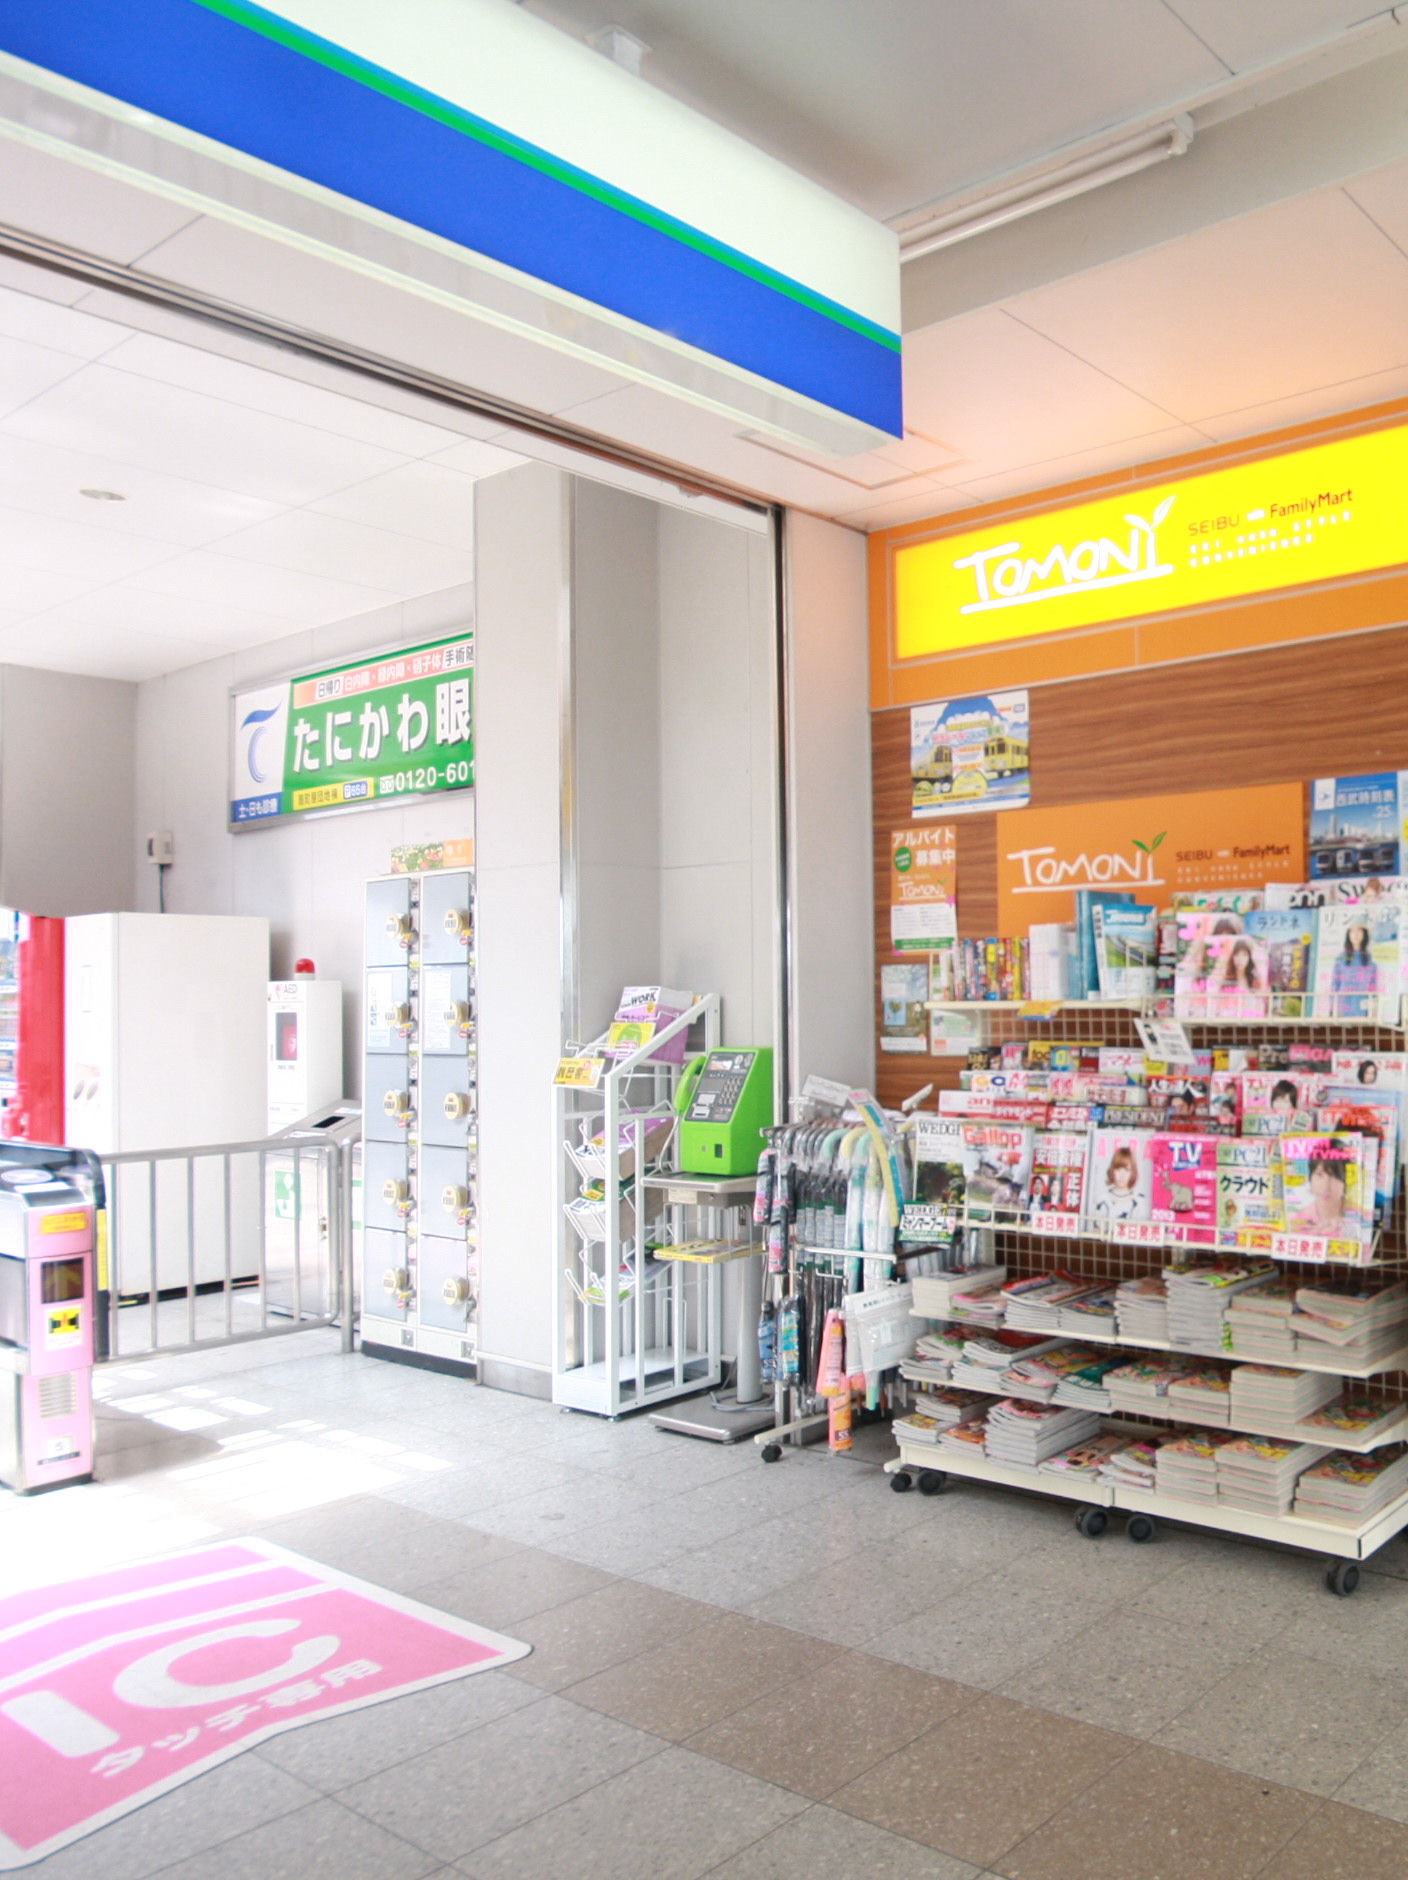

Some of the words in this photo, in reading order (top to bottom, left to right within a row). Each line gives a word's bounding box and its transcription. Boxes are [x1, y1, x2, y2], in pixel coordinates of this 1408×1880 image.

[1187, 514, 1240, 537] SEIBU
[1270, 488, 1353, 519] FamilyMart
[292, 678, 471, 774] たにかわ眼
[892, 828, 955, 848] アルバイト
[1176, 849, 1213, 862] SEIBU
[1233, 844, 1291, 860] FamilyMart
[1104, 1109, 1167, 1127] PRESIDENT
[962, 1127, 1023, 1147] Gallop
[1168, 1141, 1203, 1163] TV
[1219, 1175, 1270, 1195] クラウド
[905, 1204, 941, 1216] WEDGE
[1034, 1214, 1076, 1233] 本日発売
[1116, 1223, 1164, 1243] 本日発売
[1275, 1239, 1323, 1258] 本日発売
